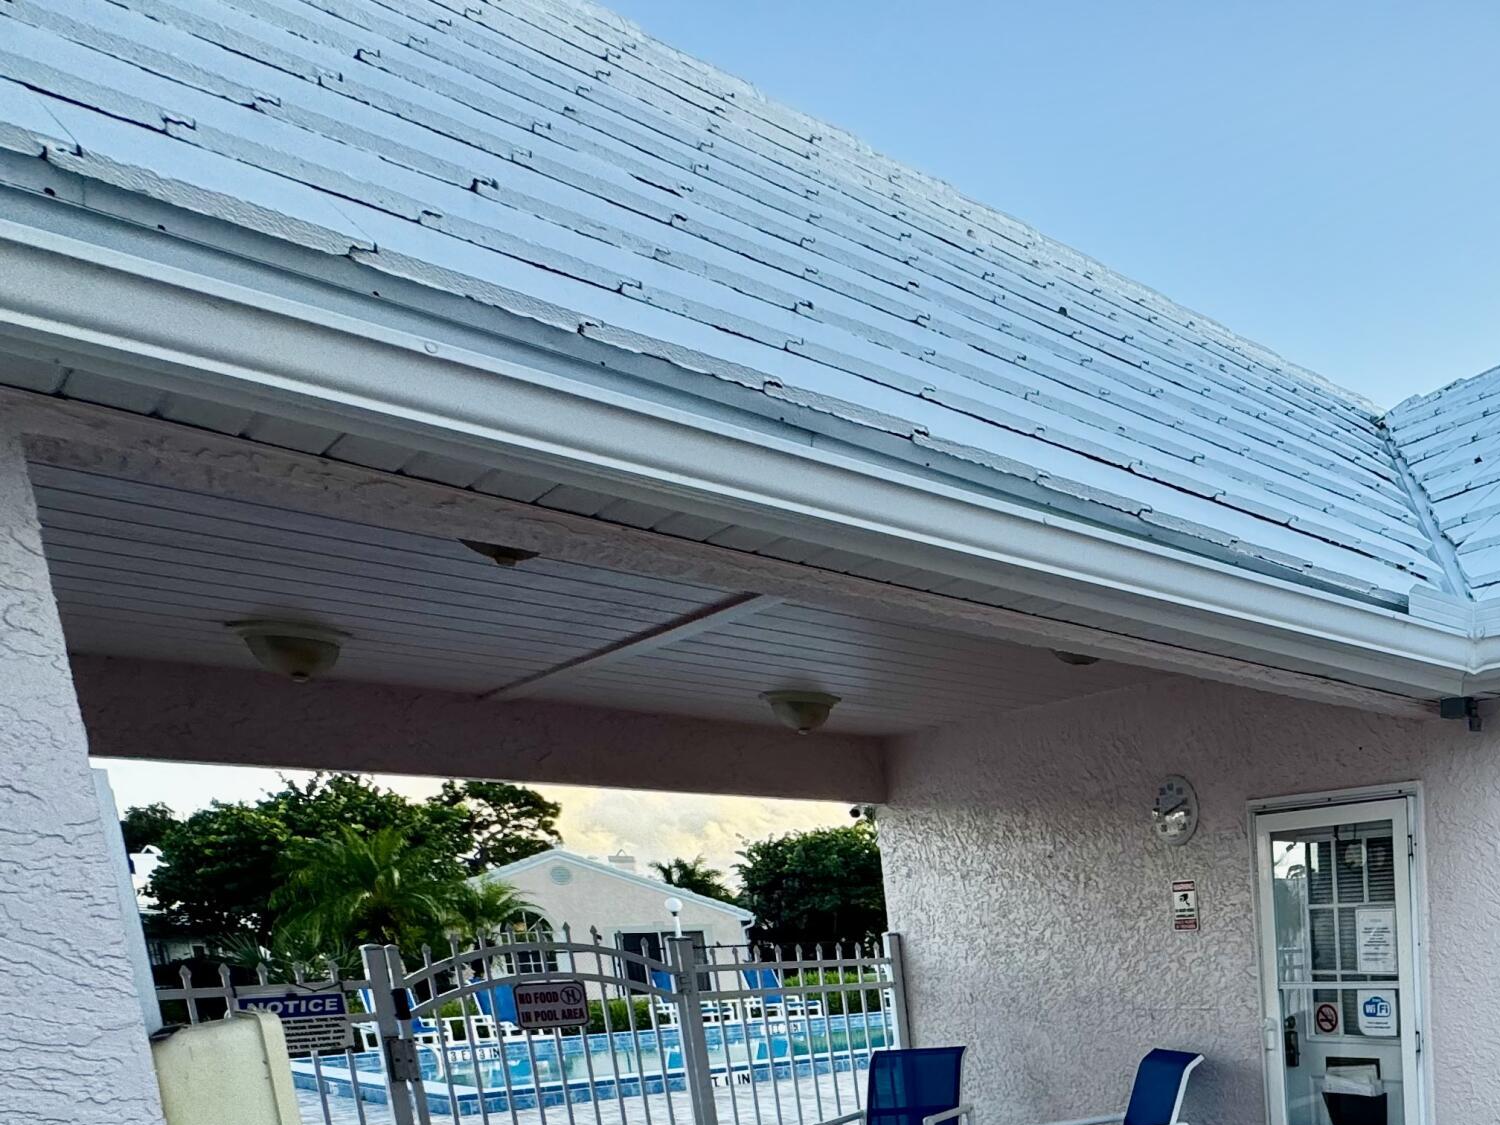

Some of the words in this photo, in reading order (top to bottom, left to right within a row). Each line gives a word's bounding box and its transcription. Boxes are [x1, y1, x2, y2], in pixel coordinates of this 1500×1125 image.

[518, 993, 532, 1005] NO
[533, 991, 560, 1004] FOOD
[246, 998, 338, 1015] NOTICE
[521, 1011, 532, 1023] IN
[534, 1009, 559, 1022] POOL
[561, 1008, 586, 1020] AREA
